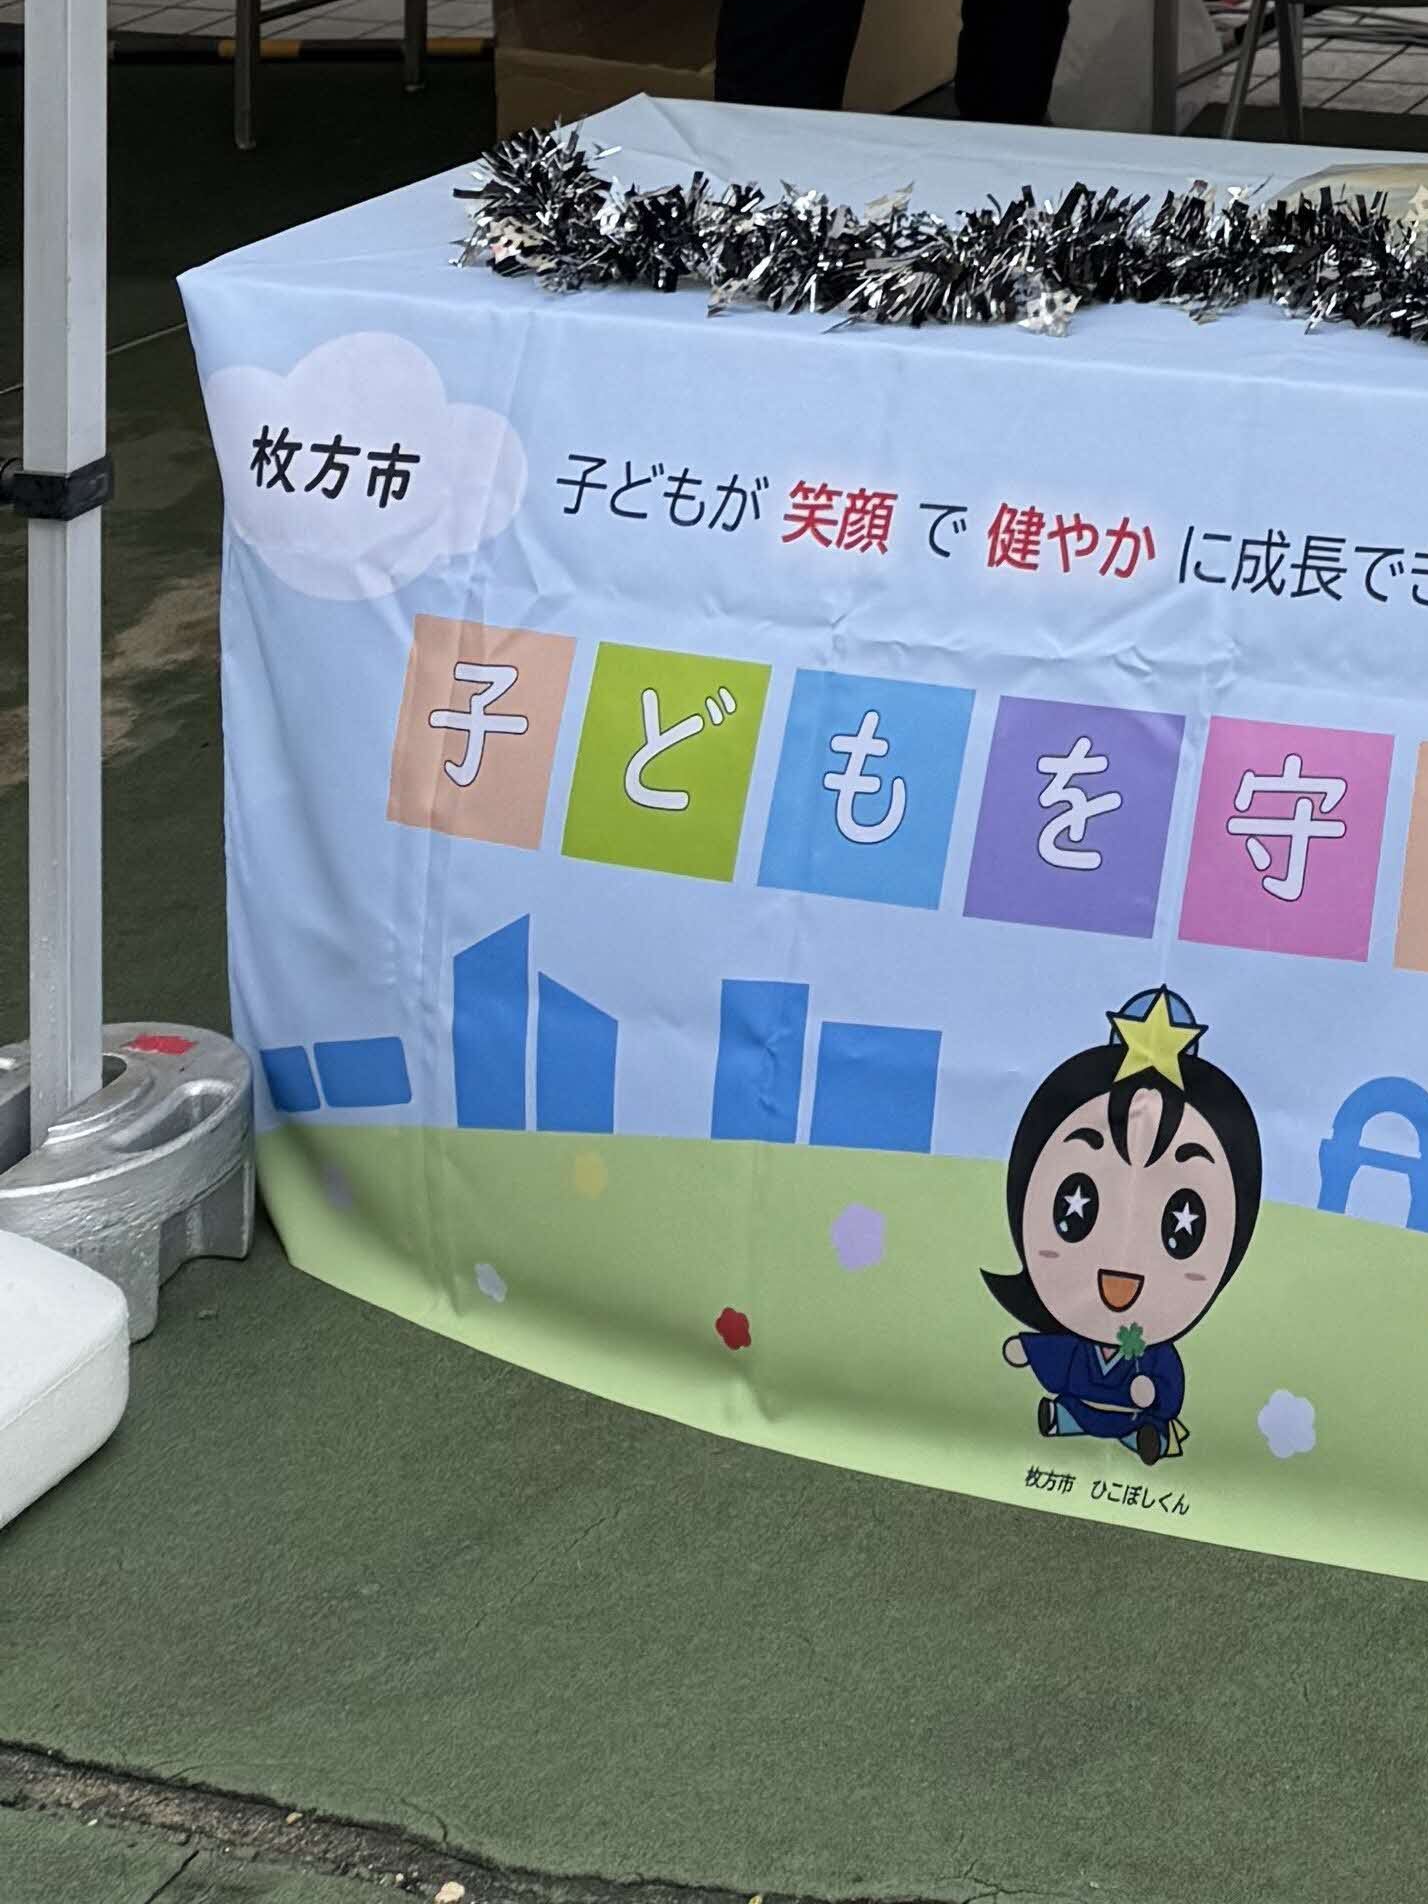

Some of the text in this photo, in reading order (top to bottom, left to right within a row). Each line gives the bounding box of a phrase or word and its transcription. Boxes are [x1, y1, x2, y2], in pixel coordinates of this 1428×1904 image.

[250, 424, 421, 504] 枚方市
[555, 453, 767, 532] 子どもが
[780, 480, 898, 555] 笑顔
[919, 501, 970, 560] で
[986, 503, 1157, 580] 健やか
[1025, 1465, 1190, 1516] 枚方市 ひこぼしくん
